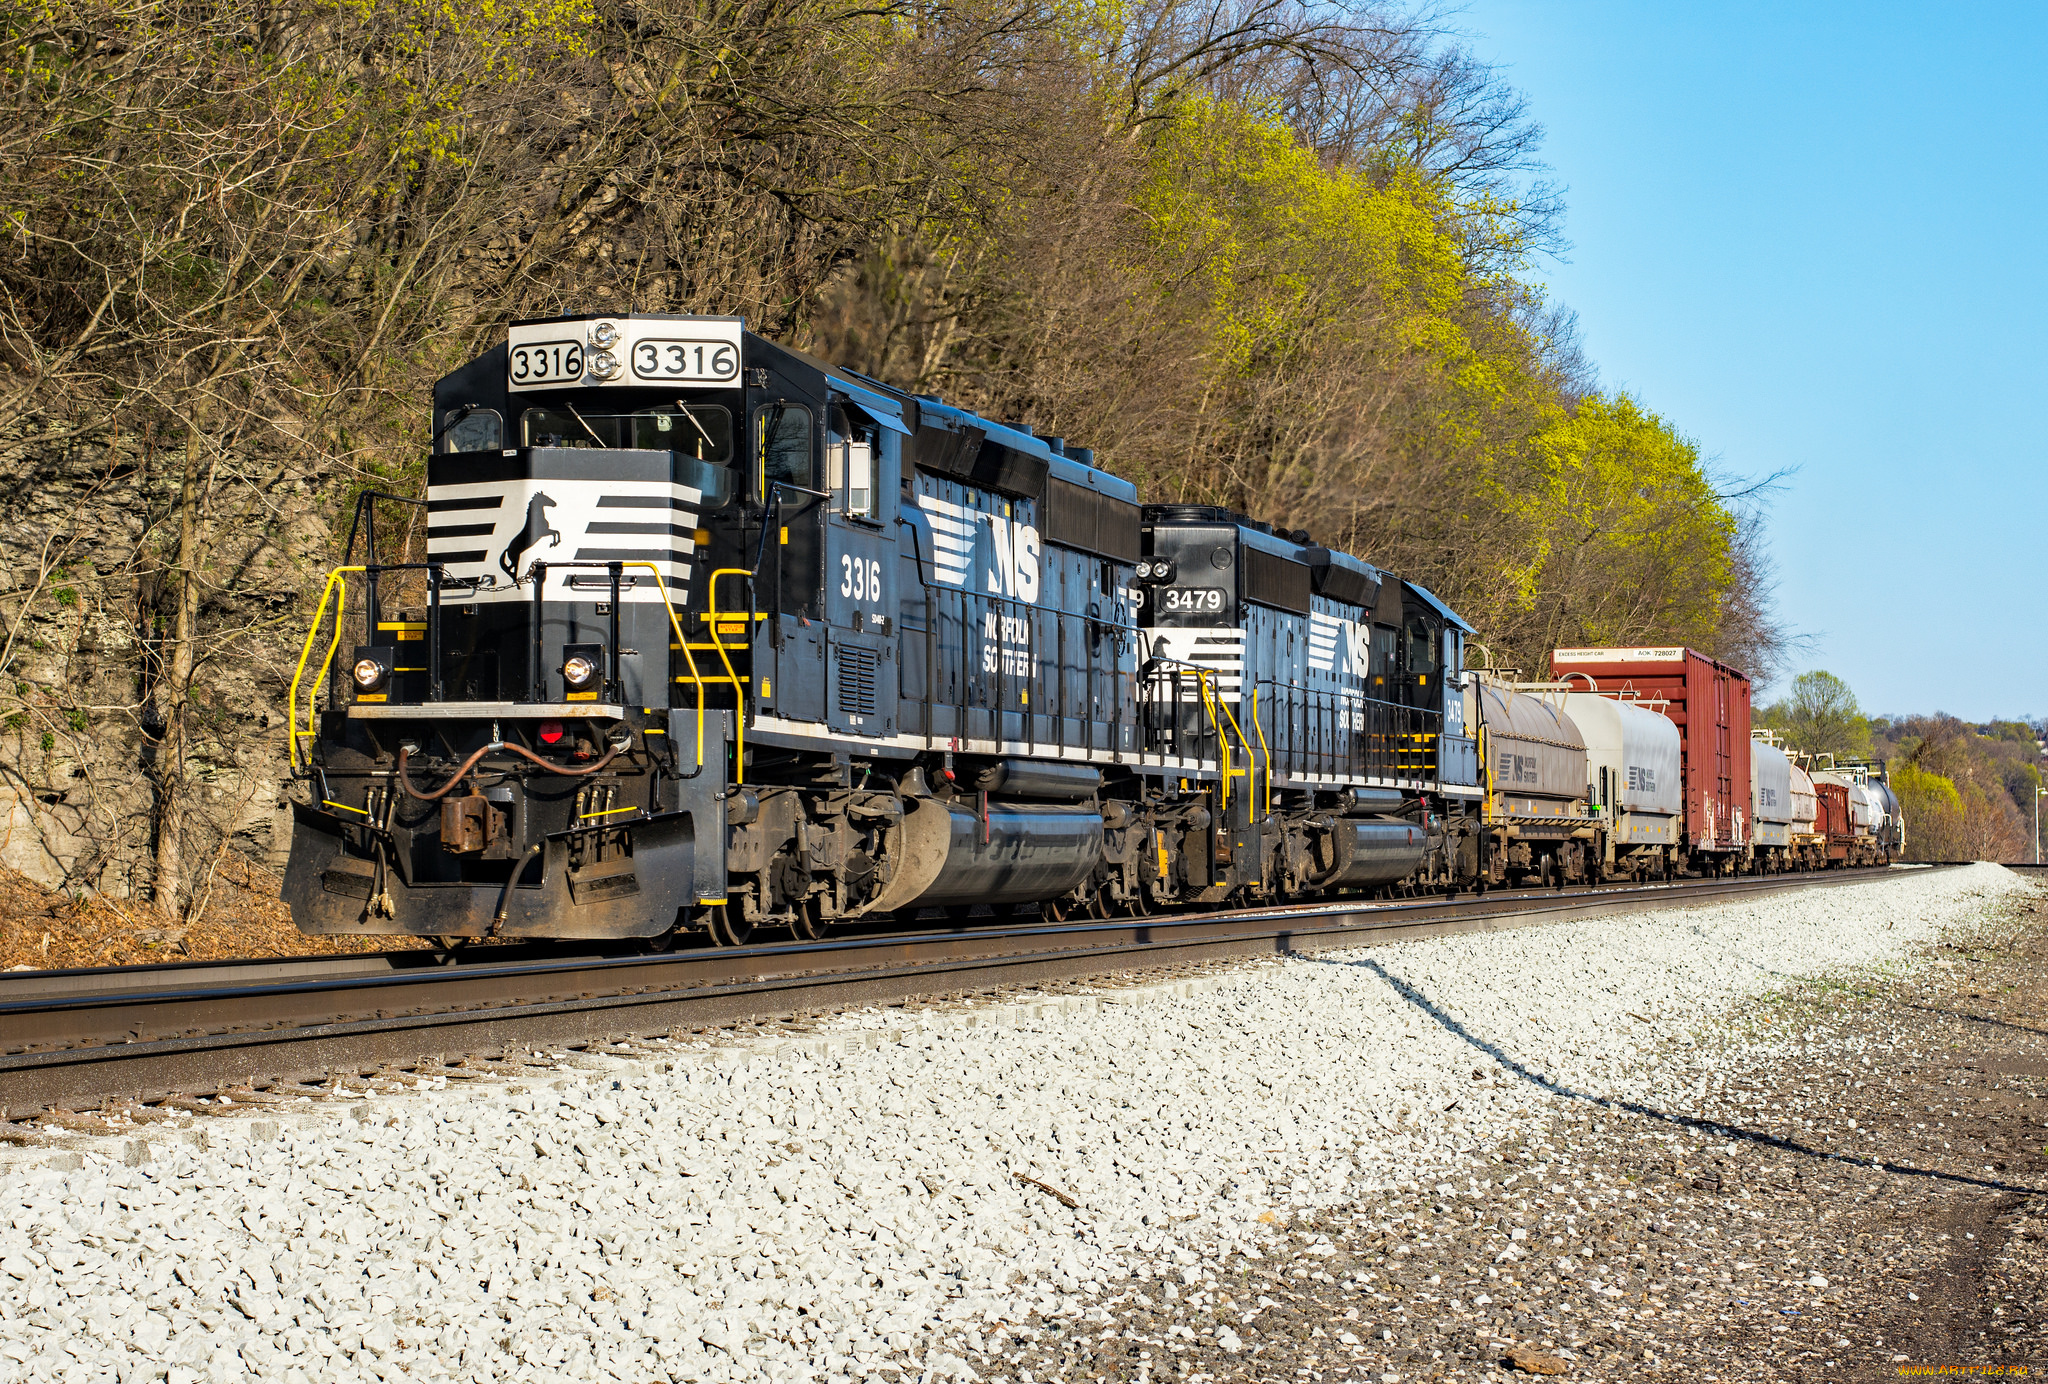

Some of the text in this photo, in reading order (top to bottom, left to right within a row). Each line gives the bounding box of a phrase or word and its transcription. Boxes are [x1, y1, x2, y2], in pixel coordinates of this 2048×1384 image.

[514, 345, 582, 380] 3316
[636, 344, 736, 376] 3316
[841, 553, 881, 603] 3316
[1166, 590, 1221, 609] 3479
[1447, 699, 1462, 724] 3479
